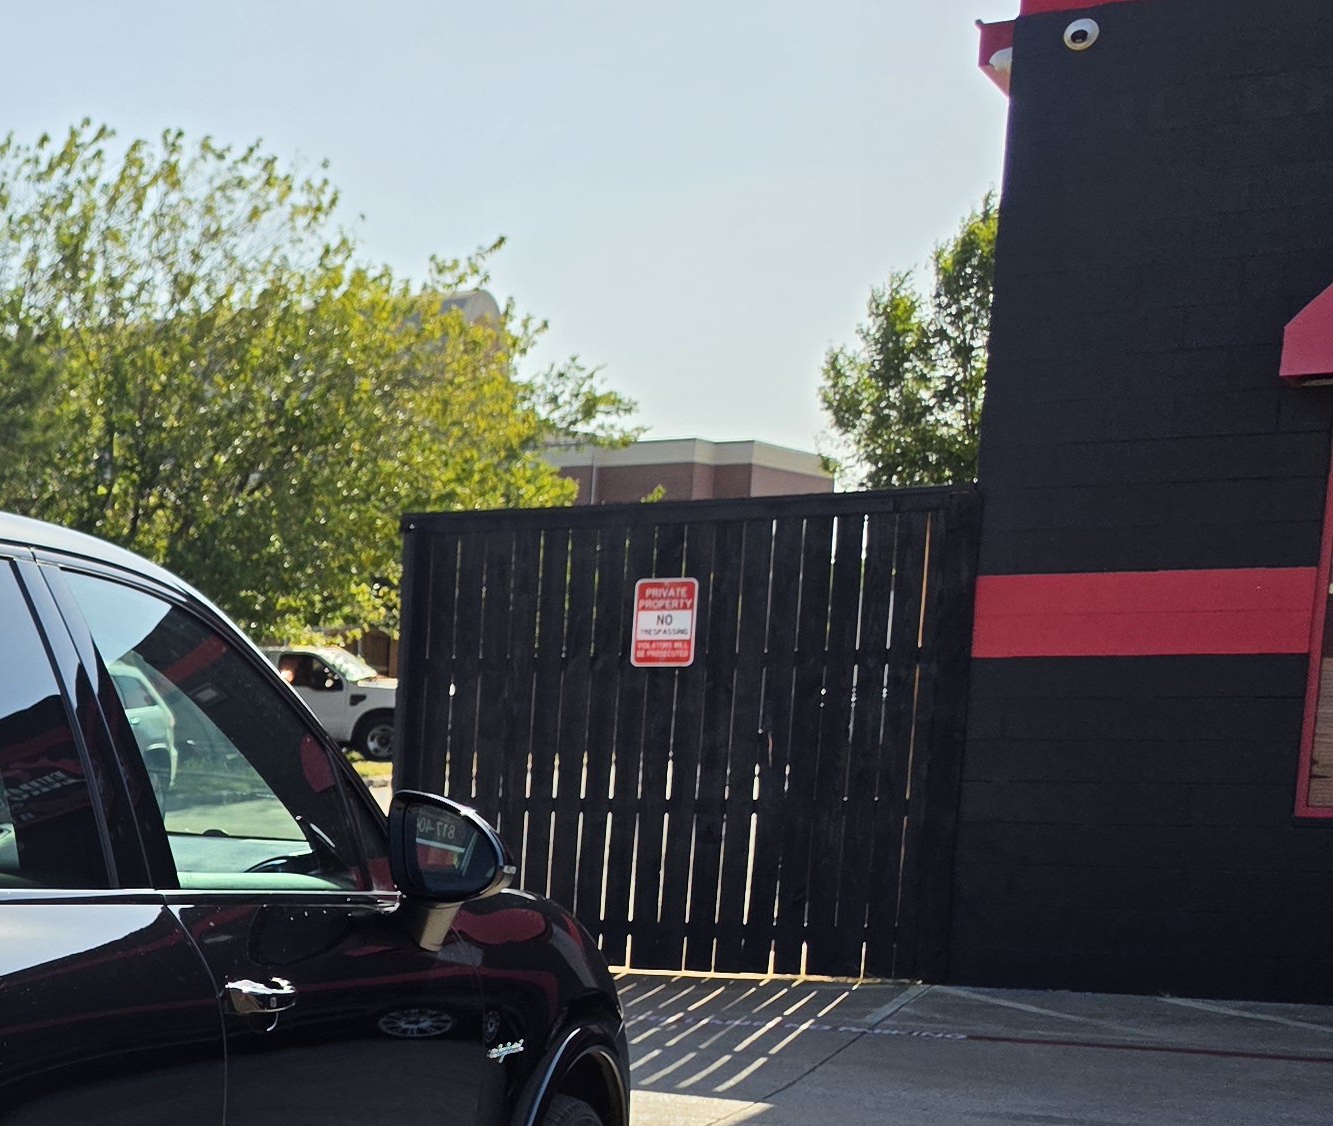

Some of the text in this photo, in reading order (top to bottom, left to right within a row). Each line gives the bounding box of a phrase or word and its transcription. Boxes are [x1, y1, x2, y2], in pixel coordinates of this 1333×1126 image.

[645, 587, 688, 599] PRIVATE
[639, 599, 693, 609] PROPERTY
[656, 614, 673, 626] NO
